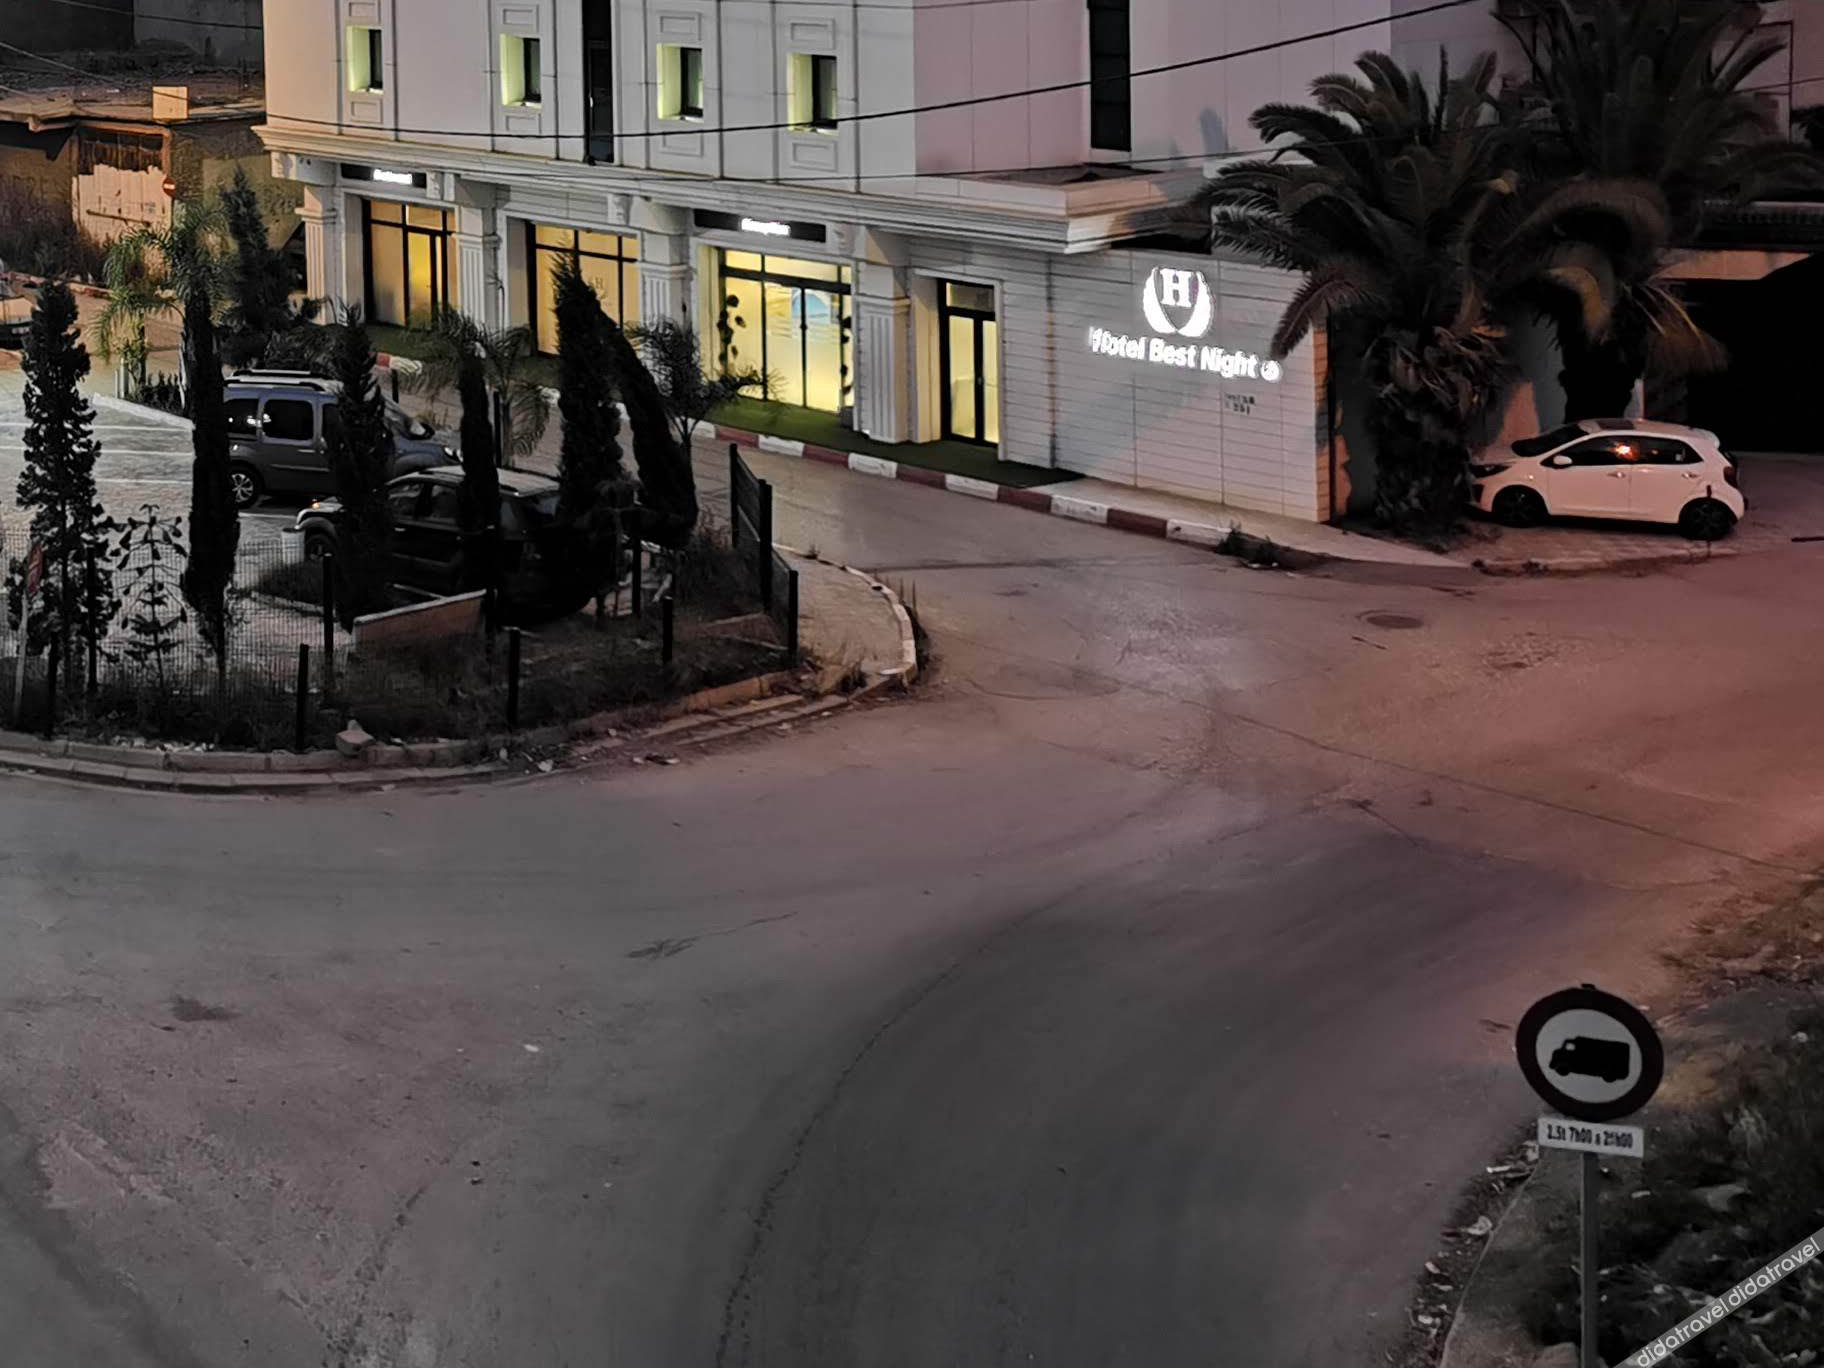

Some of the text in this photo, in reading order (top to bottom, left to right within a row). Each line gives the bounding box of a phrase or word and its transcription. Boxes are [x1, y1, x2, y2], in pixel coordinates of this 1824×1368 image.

[1159, 268, 1192, 307] H
[1088, 326, 1146, 360] Hotel
[1148, 338, 1197, 368] Best
[1200, 346, 1259, 378] Night
